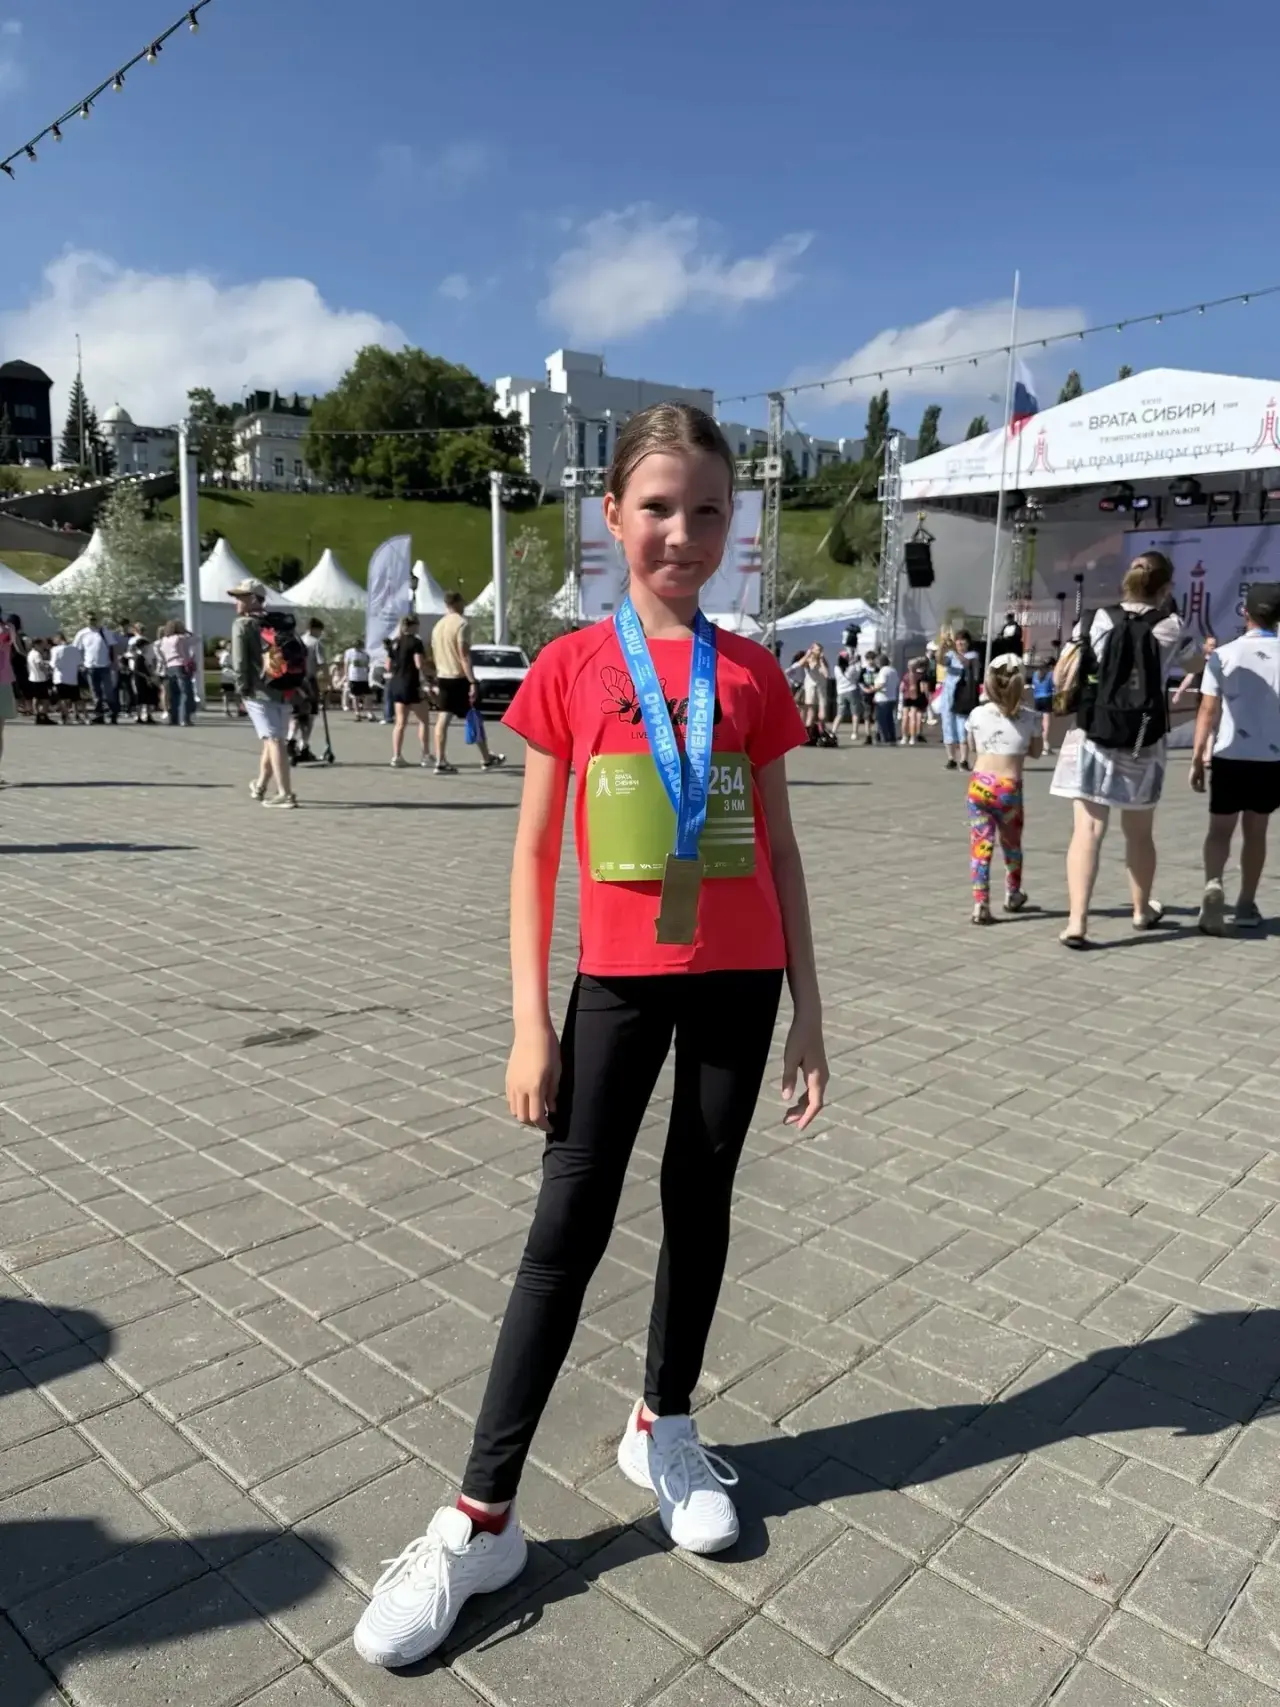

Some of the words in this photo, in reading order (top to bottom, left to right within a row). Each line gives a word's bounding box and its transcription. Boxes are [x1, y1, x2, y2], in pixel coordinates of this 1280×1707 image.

[1088, 412, 1137, 430] ВРАТА
[1142, 401, 1215, 423] СИБИРИ
[1067, 457, 1083, 469] НА
[1089, 447, 1187, 465] ПРАВИЛЬНОМ
[1193, 442, 1234, 457] ПУТИ
[724, 800, 730, 811] 3
